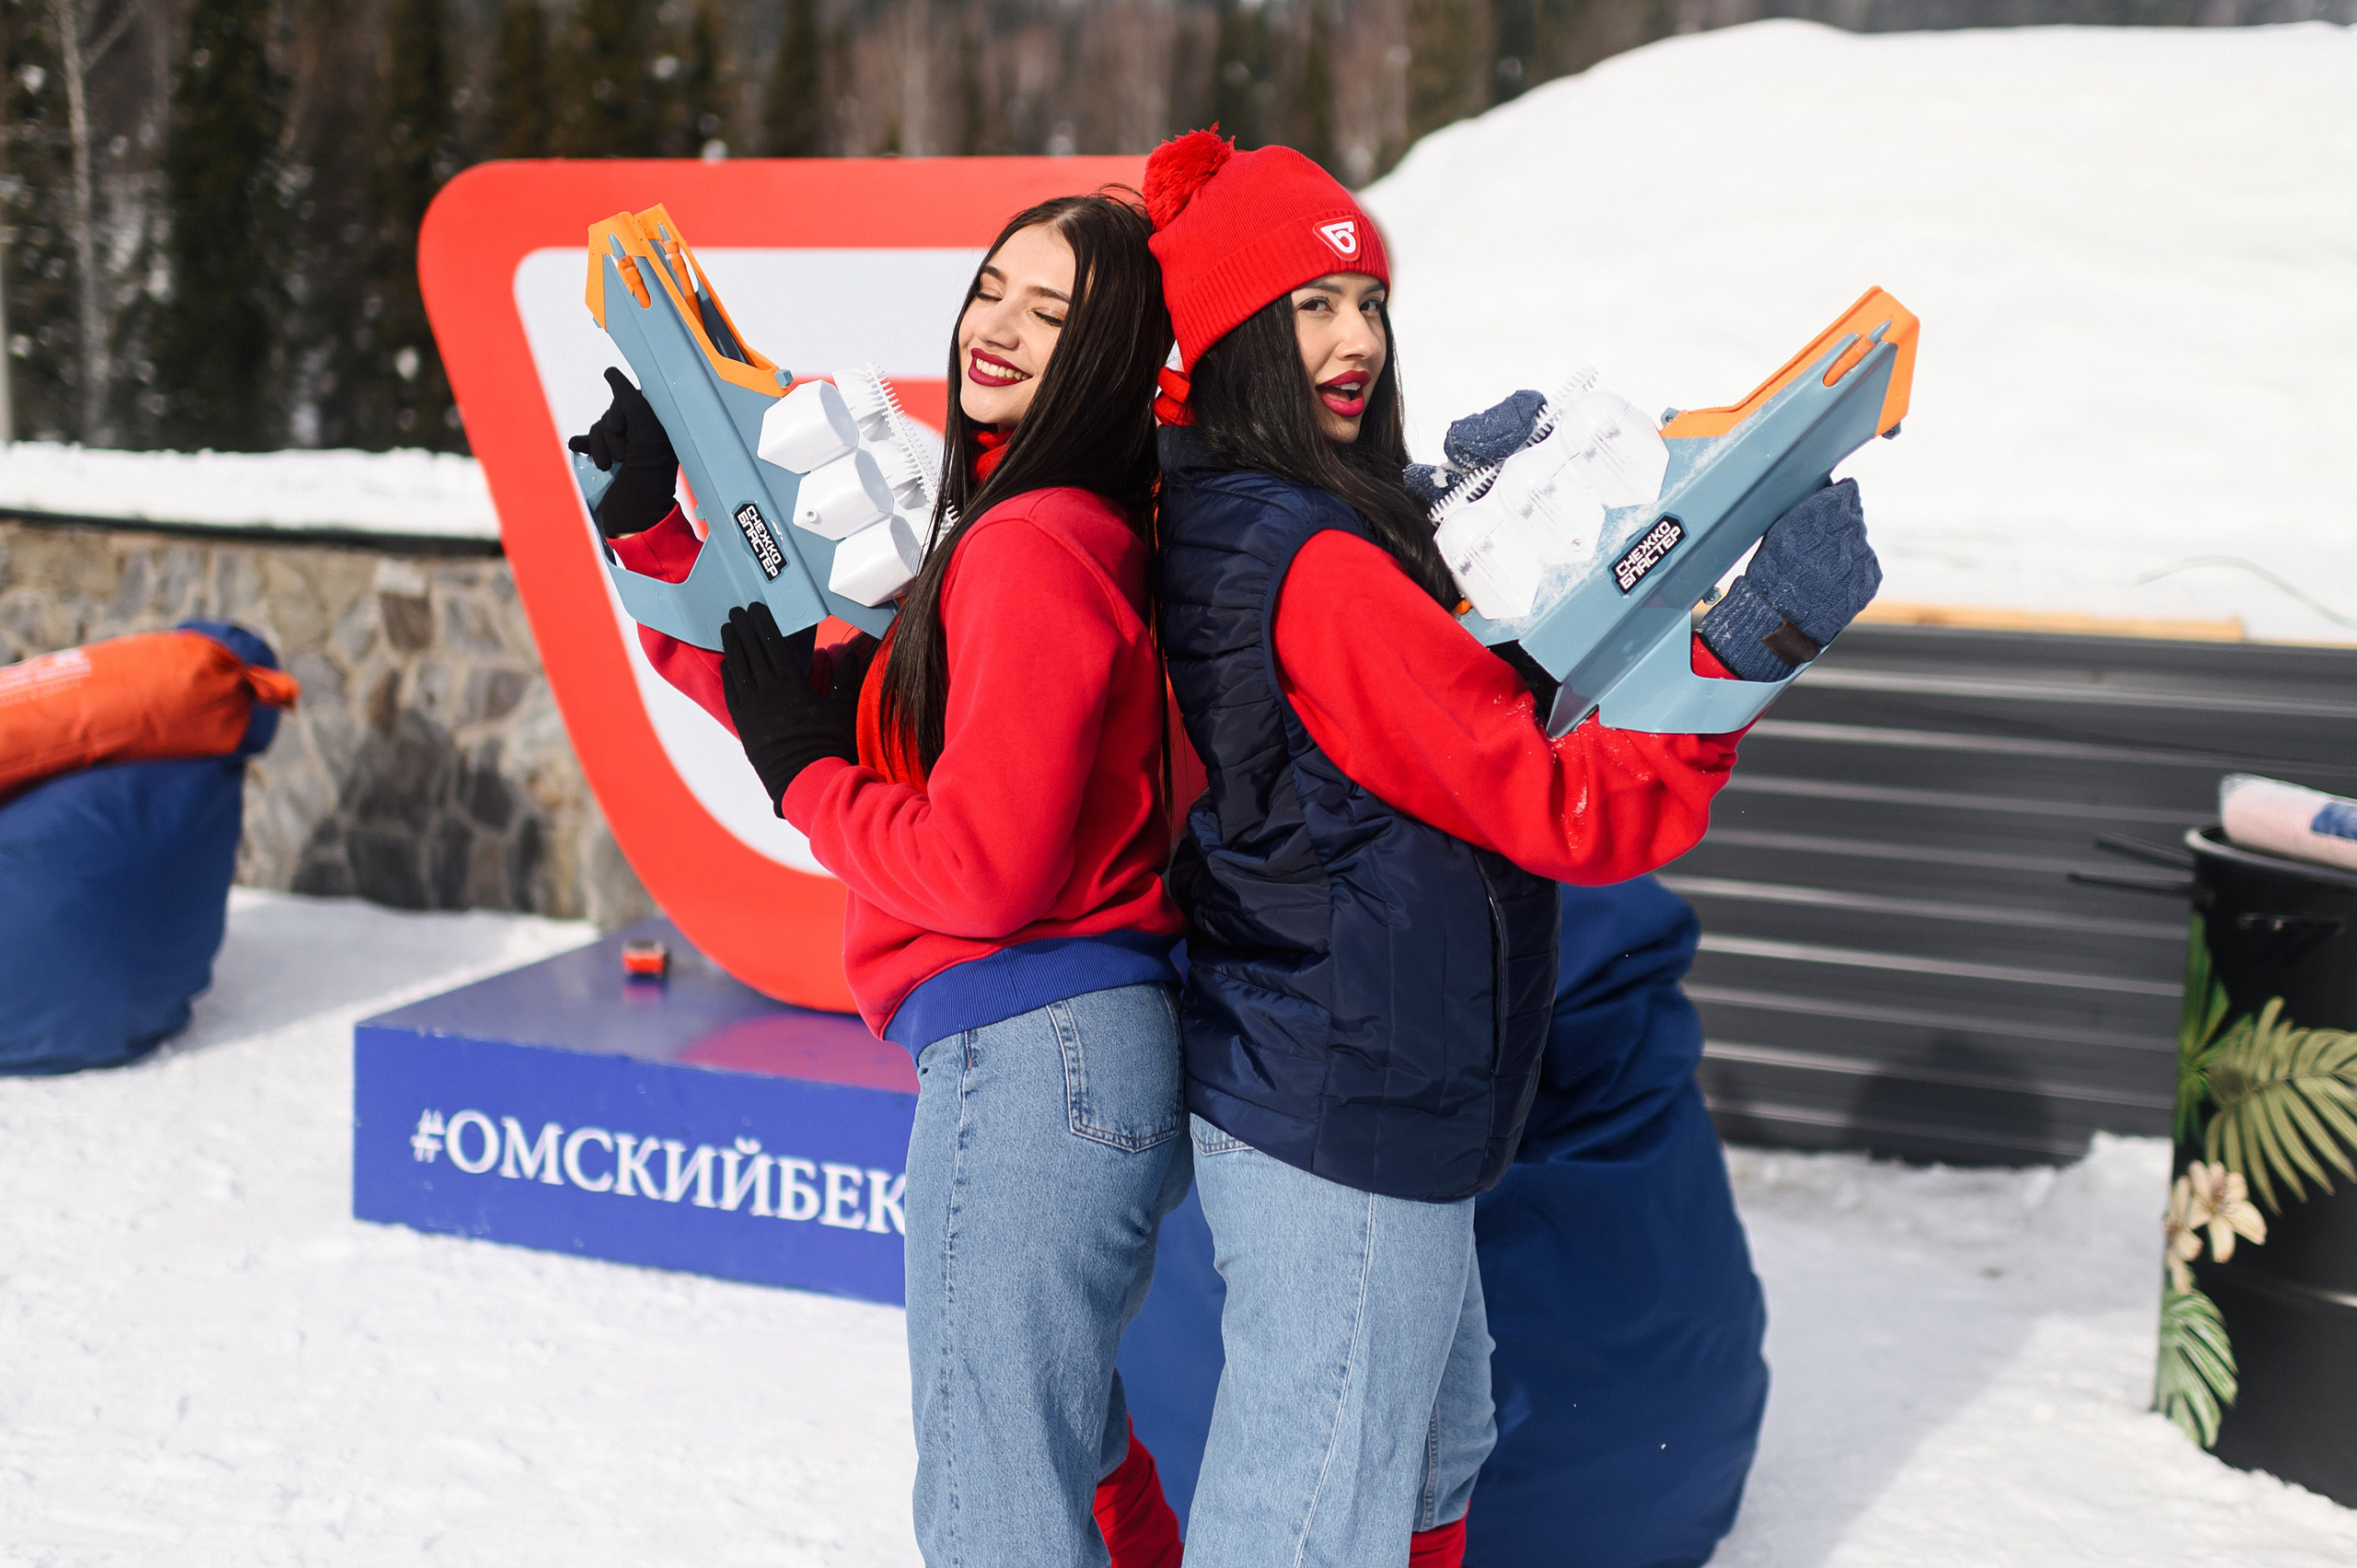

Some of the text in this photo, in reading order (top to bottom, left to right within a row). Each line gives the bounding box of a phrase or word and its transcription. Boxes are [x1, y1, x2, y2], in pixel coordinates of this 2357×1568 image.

[737, 511, 779, 577] БЛАСТЕР
[746, 505, 782, 564] СНЕЖКО
[1615, 520, 1671, 577] СНЕЖКО
[1619, 526, 1681, 590] БЛАСТЕР
